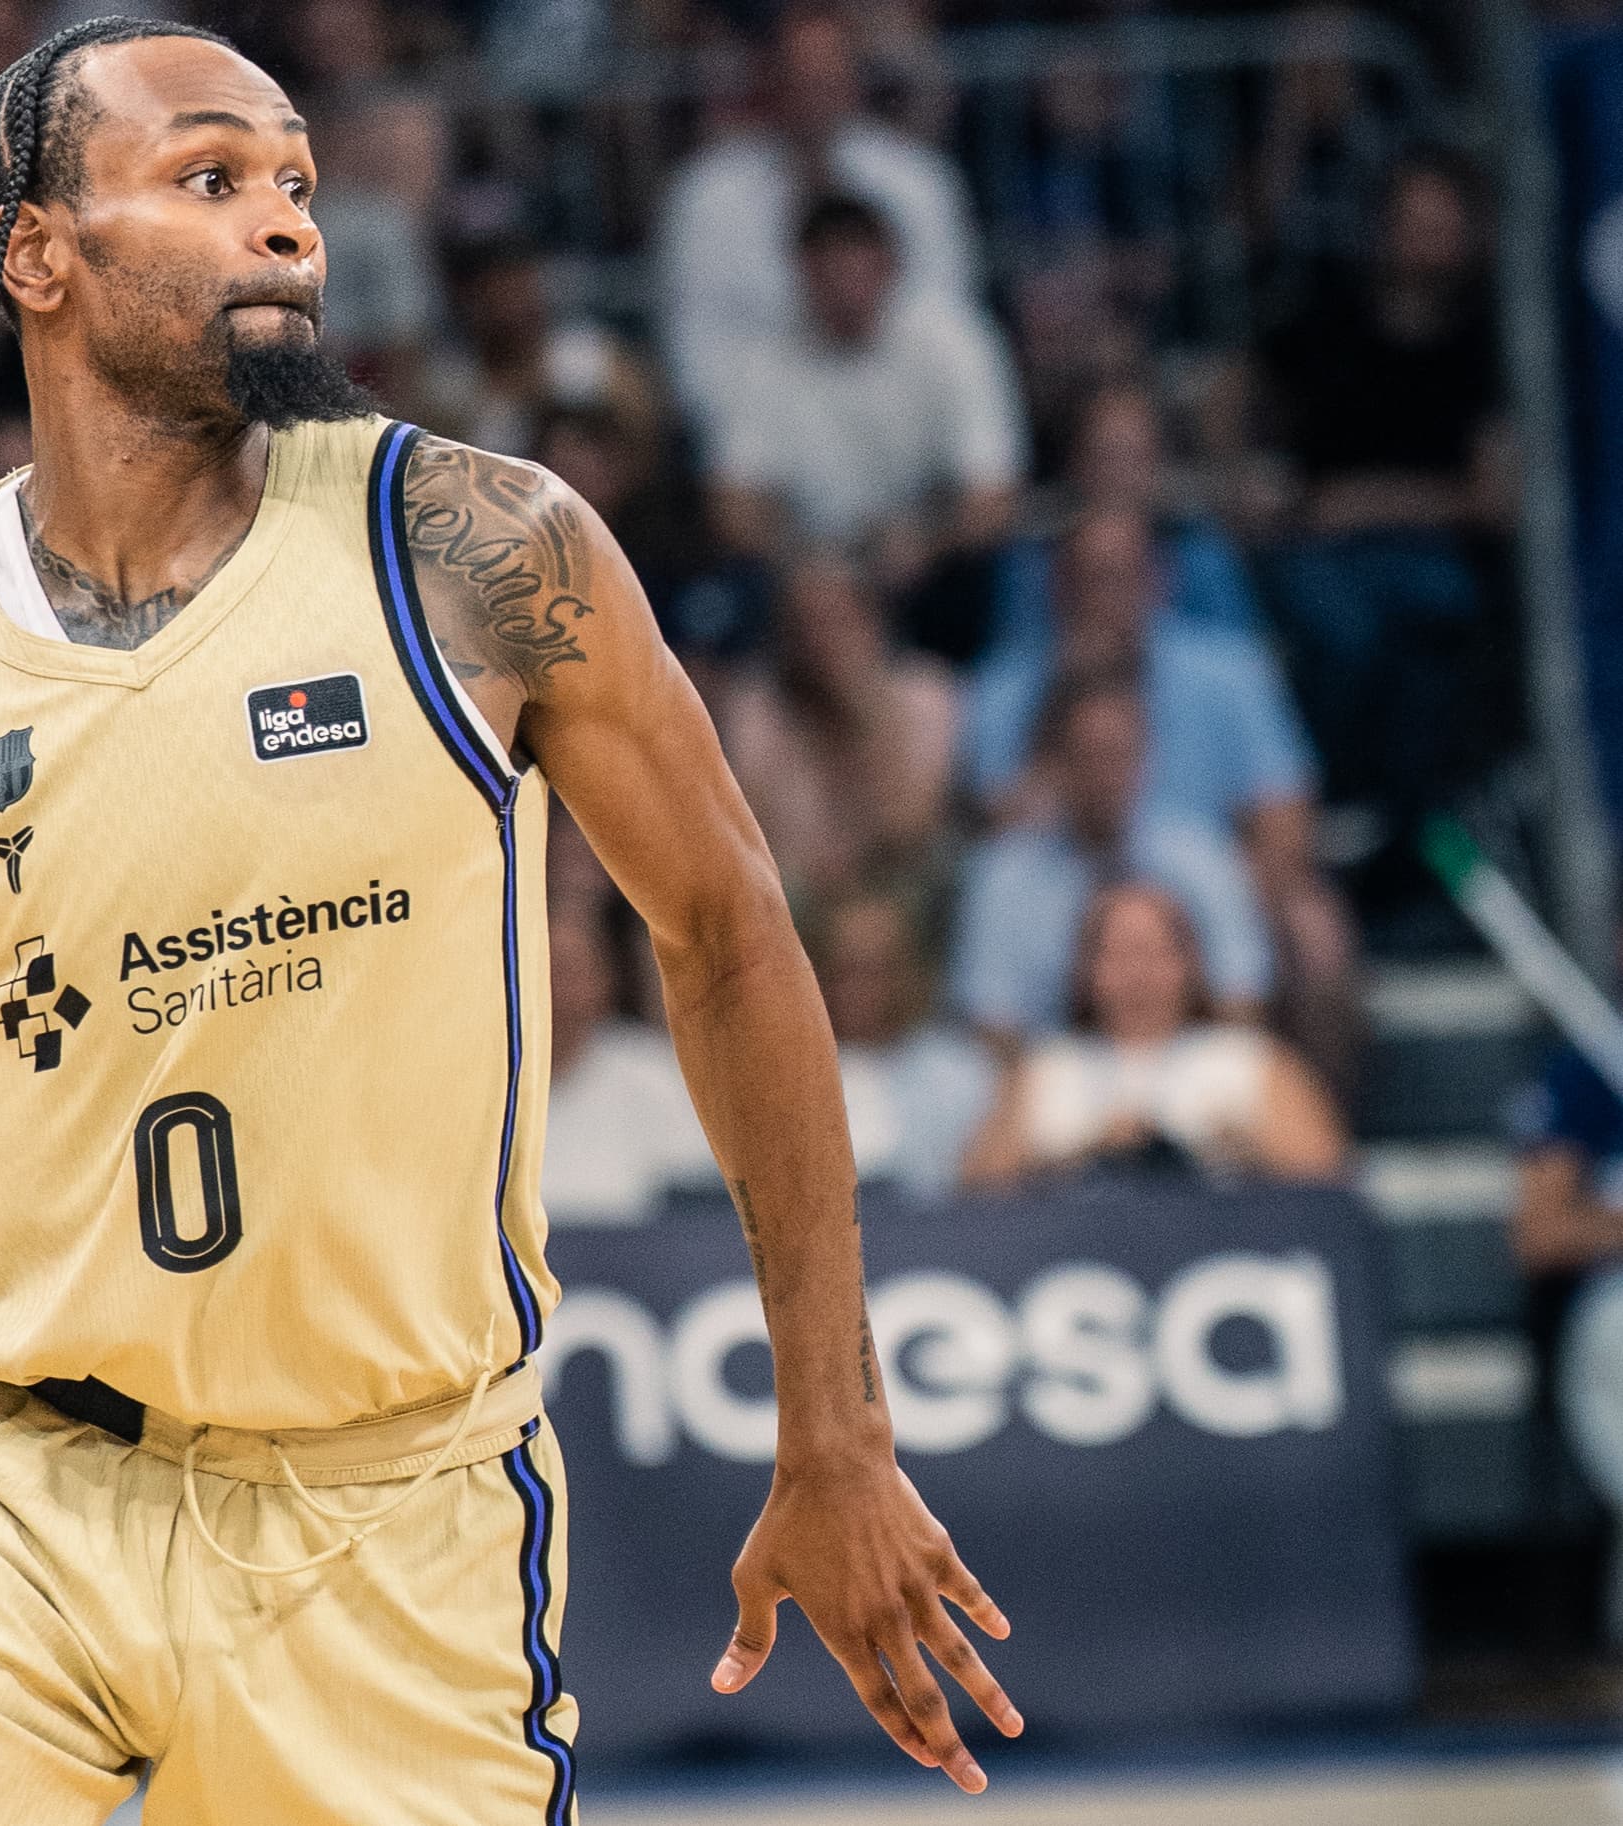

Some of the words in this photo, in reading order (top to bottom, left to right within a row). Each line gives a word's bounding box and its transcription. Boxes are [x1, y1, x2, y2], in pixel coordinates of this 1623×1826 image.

[259, 708, 305, 731] liga
[263, 721, 362, 751] endesa
[118, 880, 412, 982] Assistència
[127, 949, 324, 1035] Sanitària
[133, 1091, 244, 1274] 0
